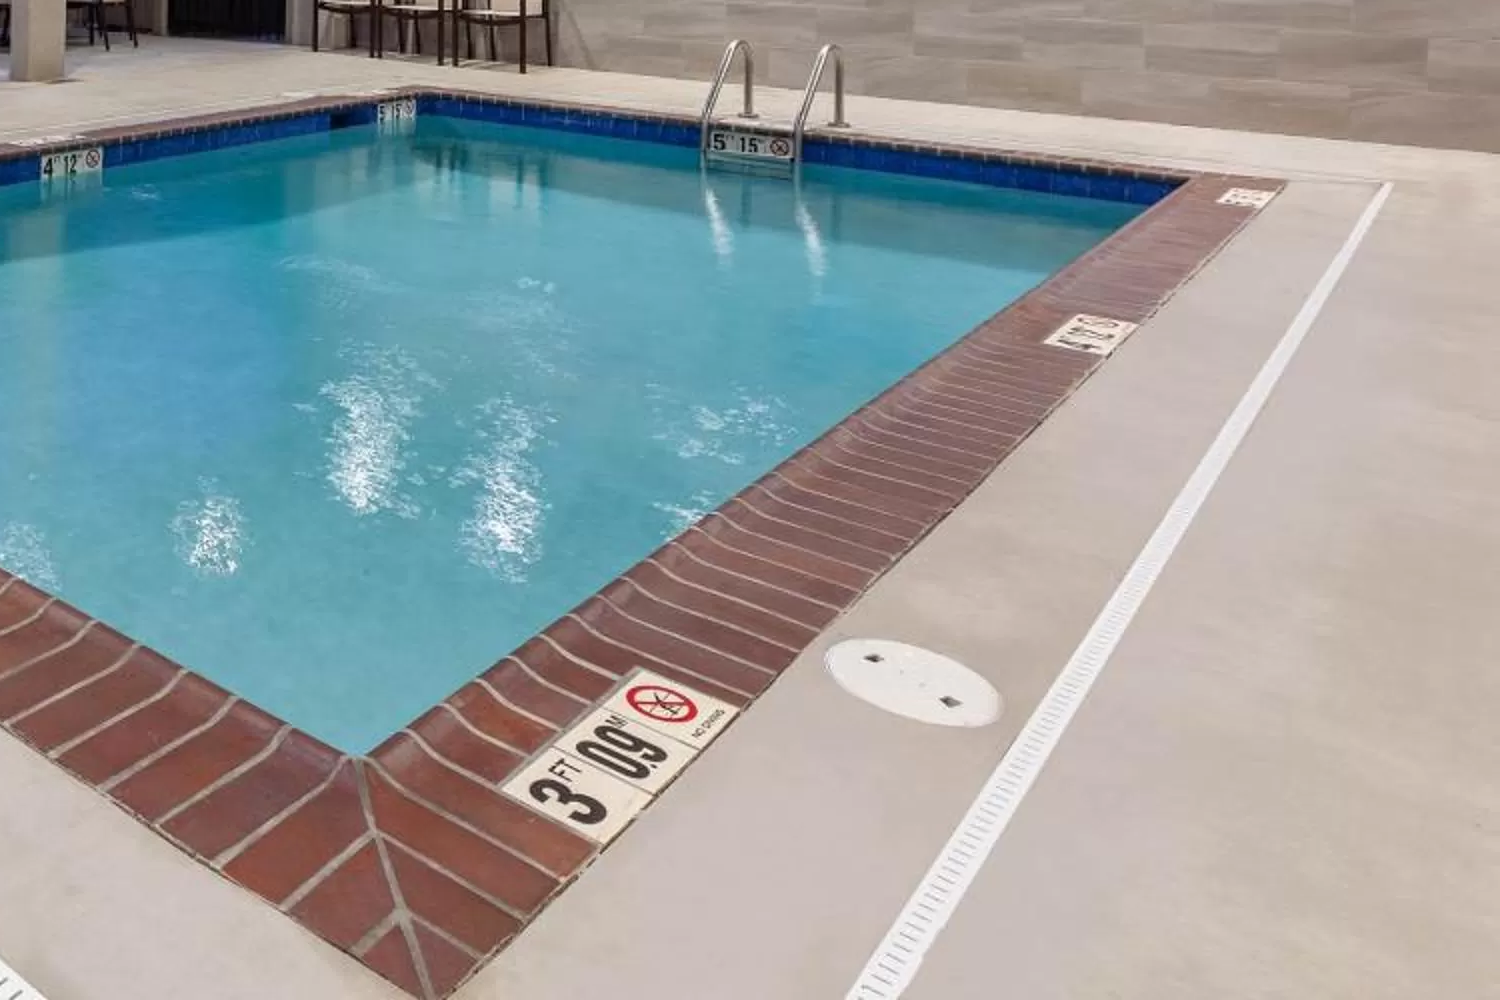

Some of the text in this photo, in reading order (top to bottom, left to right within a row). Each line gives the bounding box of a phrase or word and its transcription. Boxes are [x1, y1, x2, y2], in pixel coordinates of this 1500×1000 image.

[713, 134, 726, 150] 5
[44, 158, 52, 174] 4
[604, 715, 628, 728] M
[548, 758, 582, 782] FT
[529, 778, 607, 825] 3
